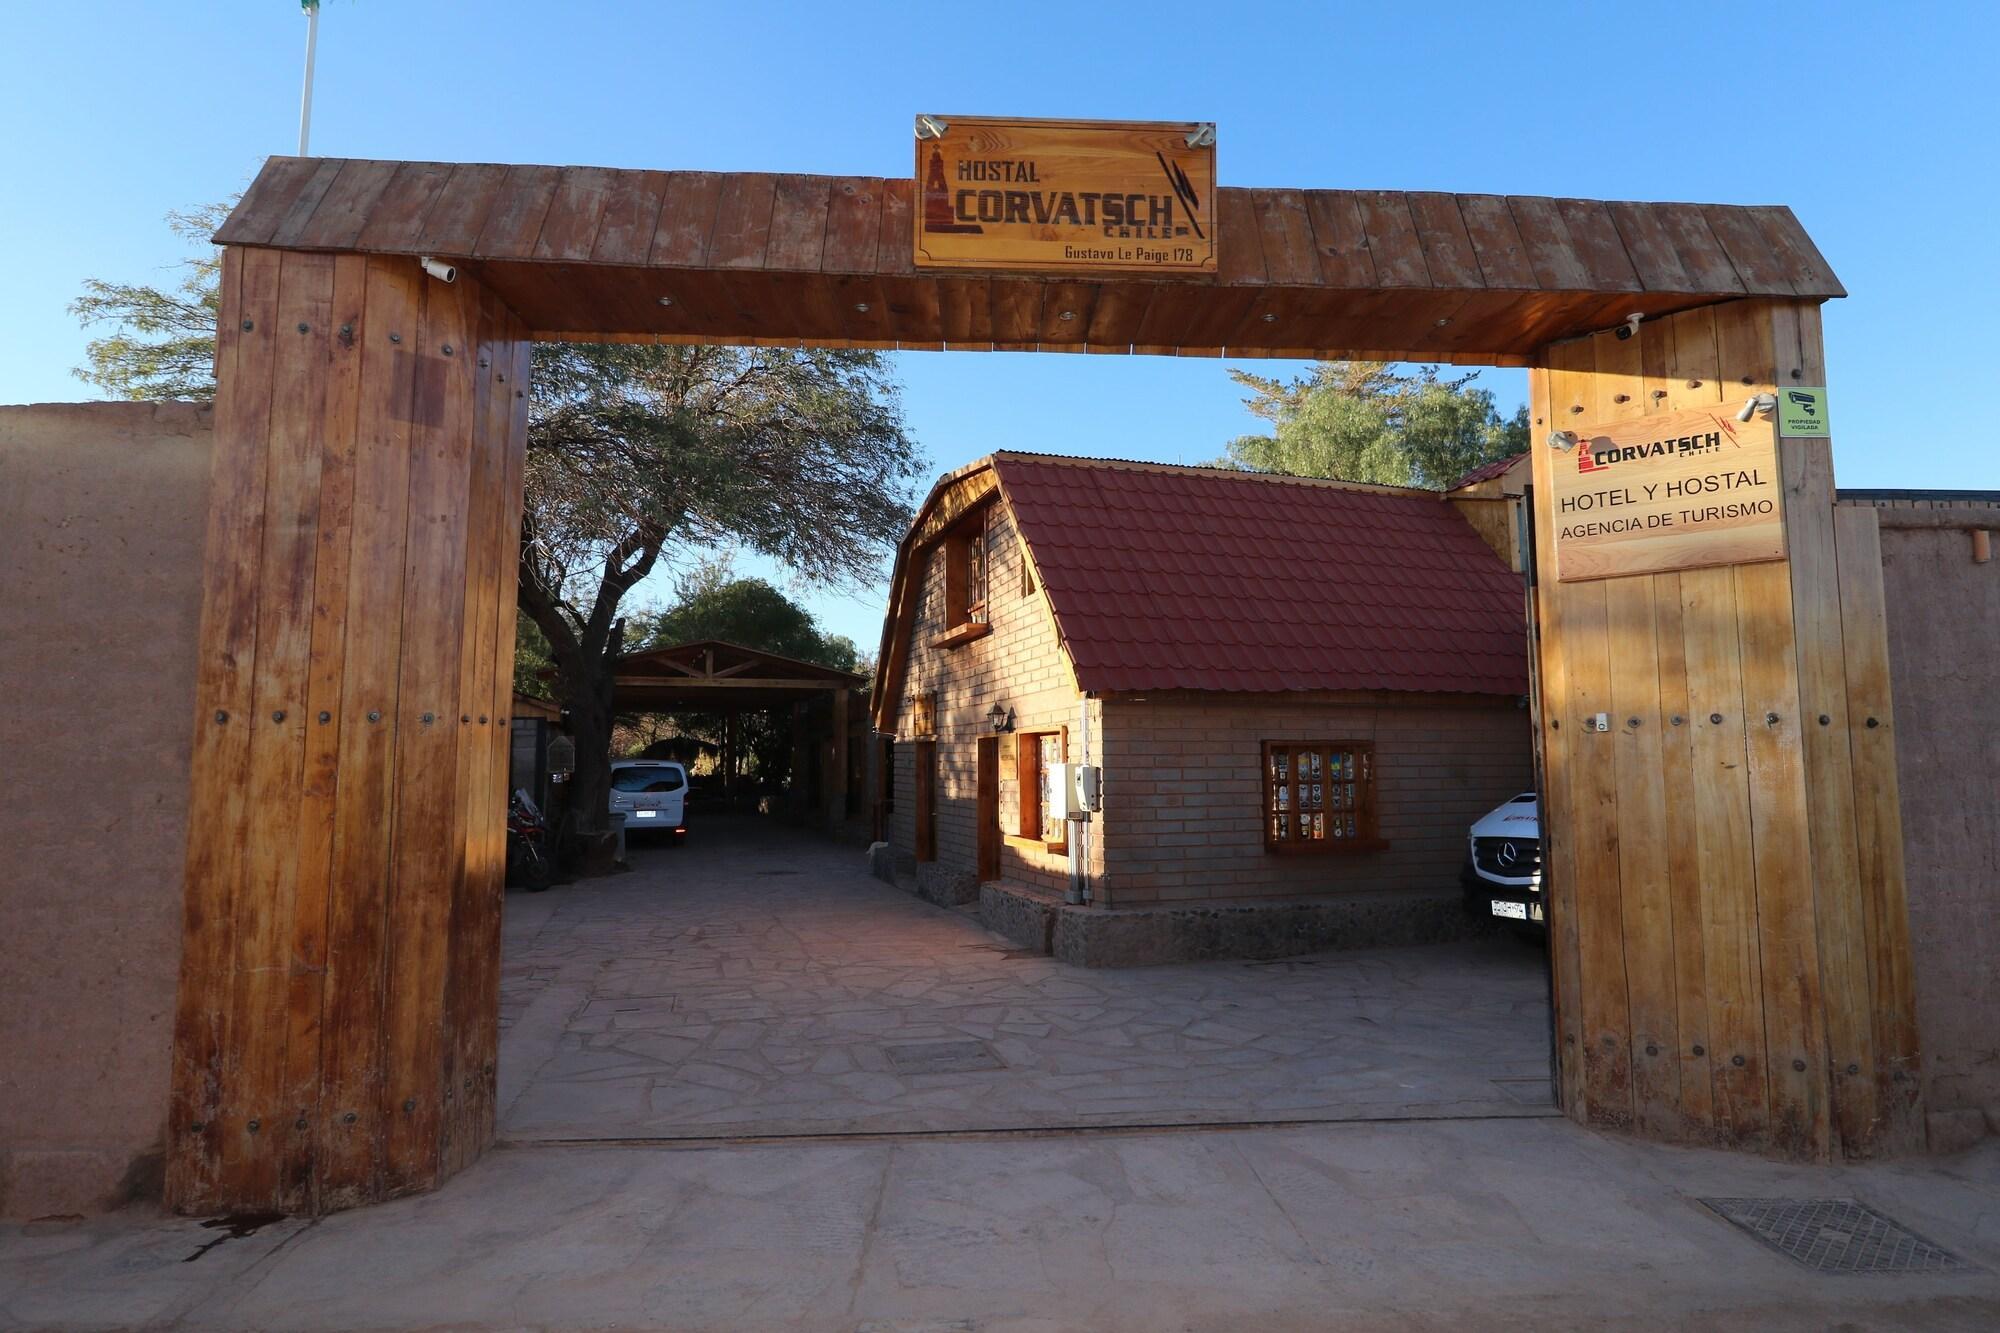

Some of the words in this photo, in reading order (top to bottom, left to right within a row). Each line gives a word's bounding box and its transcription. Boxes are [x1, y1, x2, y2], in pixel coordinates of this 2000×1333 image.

[958, 160, 1040, 183] HOSTAL
[956, 189, 1173, 226] CORVATSCH
[1103, 226, 1172, 239] CHILE
[1065, 245, 1114, 260] Gustavo
[1118, 247, 1132, 260] Le
[1136, 247, 1169, 264] Paige
[1173, 248, 1193, 262] 178
[1595, 431, 1721, 466] CORVATSCH
[1679, 446, 1721, 458] CHILE
[1561, 488, 1637, 513] HOTEL
[1643, 483, 1659, 501] Y
[1666, 468, 1767, 498] HOSTAL
[1560, 517, 1643, 540] AGENCIA
[1648, 512, 1673, 529] DE
[1679, 499, 1773, 524] TURISMO
